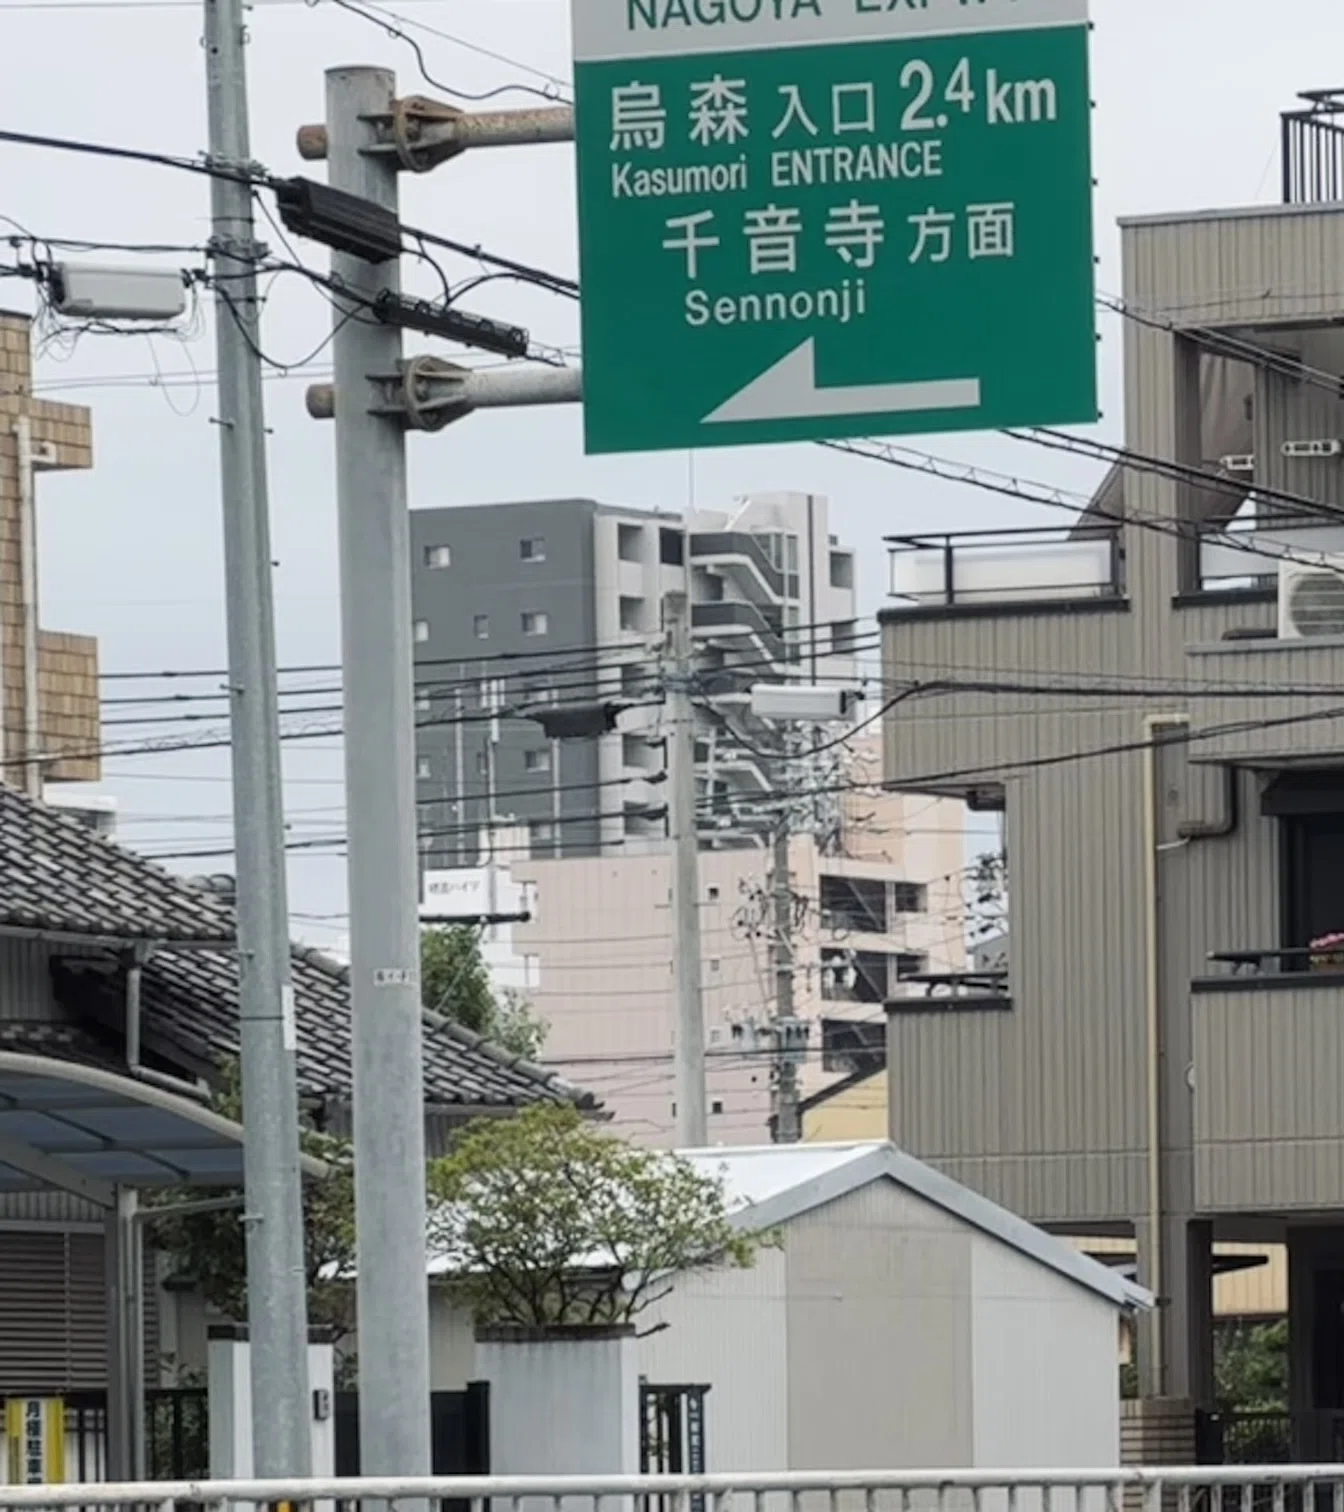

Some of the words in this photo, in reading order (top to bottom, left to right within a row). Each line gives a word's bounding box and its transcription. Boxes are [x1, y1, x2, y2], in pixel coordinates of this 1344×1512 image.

[611, 155, 748, 198] Kasumori
[771, 140, 943, 187] ENTRANCE
[684, 279, 866, 326] Sennonji
